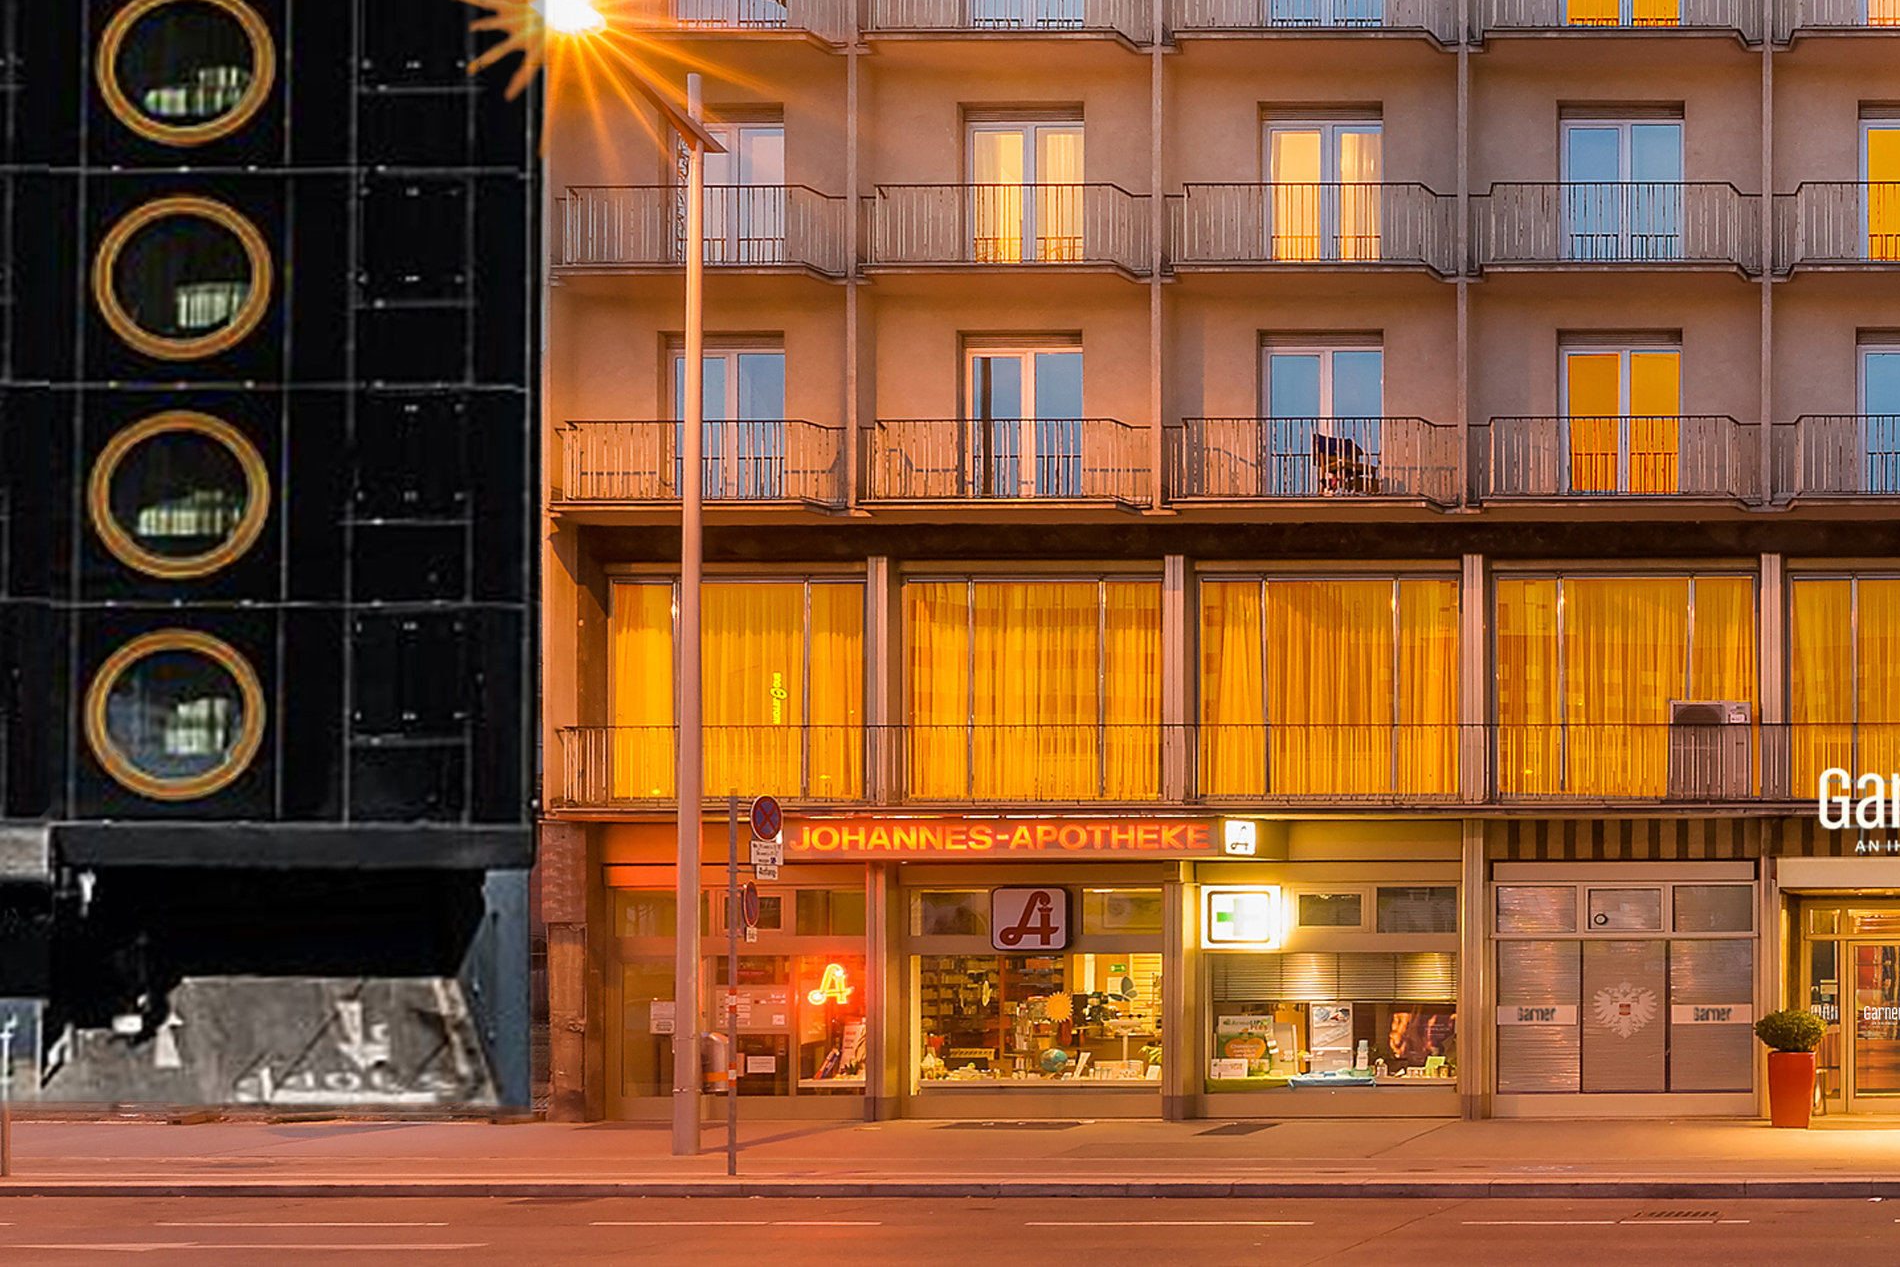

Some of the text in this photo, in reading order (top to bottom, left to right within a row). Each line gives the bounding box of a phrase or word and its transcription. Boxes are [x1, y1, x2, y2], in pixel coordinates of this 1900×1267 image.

[789, 824, 1211, 851] JOHANNES-APOTHEKE
[1855, 839, 1880, 852] AN
[1517, 1006, 1556, 1022] Garner
[1693, 1006, 1732, 1022] Garner
